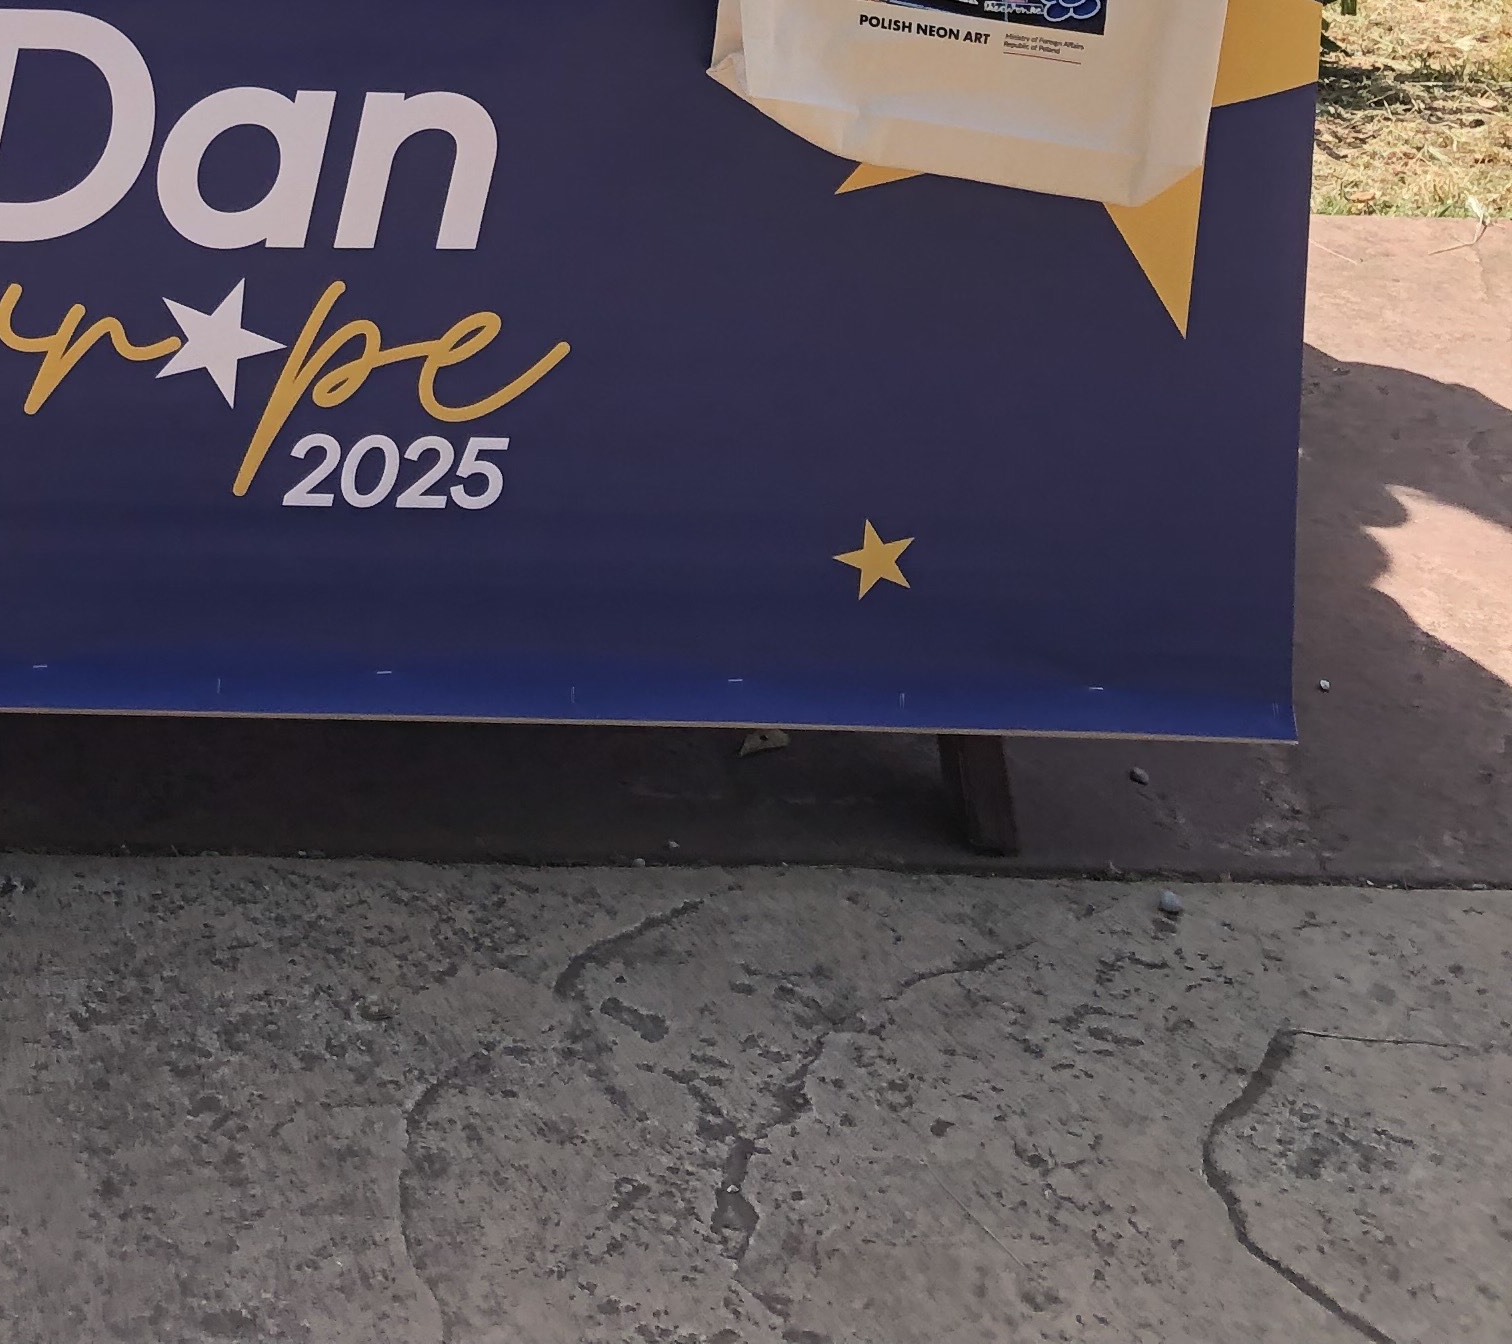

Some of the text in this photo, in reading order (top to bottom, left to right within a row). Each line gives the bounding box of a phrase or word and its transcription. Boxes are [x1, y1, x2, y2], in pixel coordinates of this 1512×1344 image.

[859, 14, 991, 45] POLISH NEON ART
[282, 433, 510, 509] 2025
